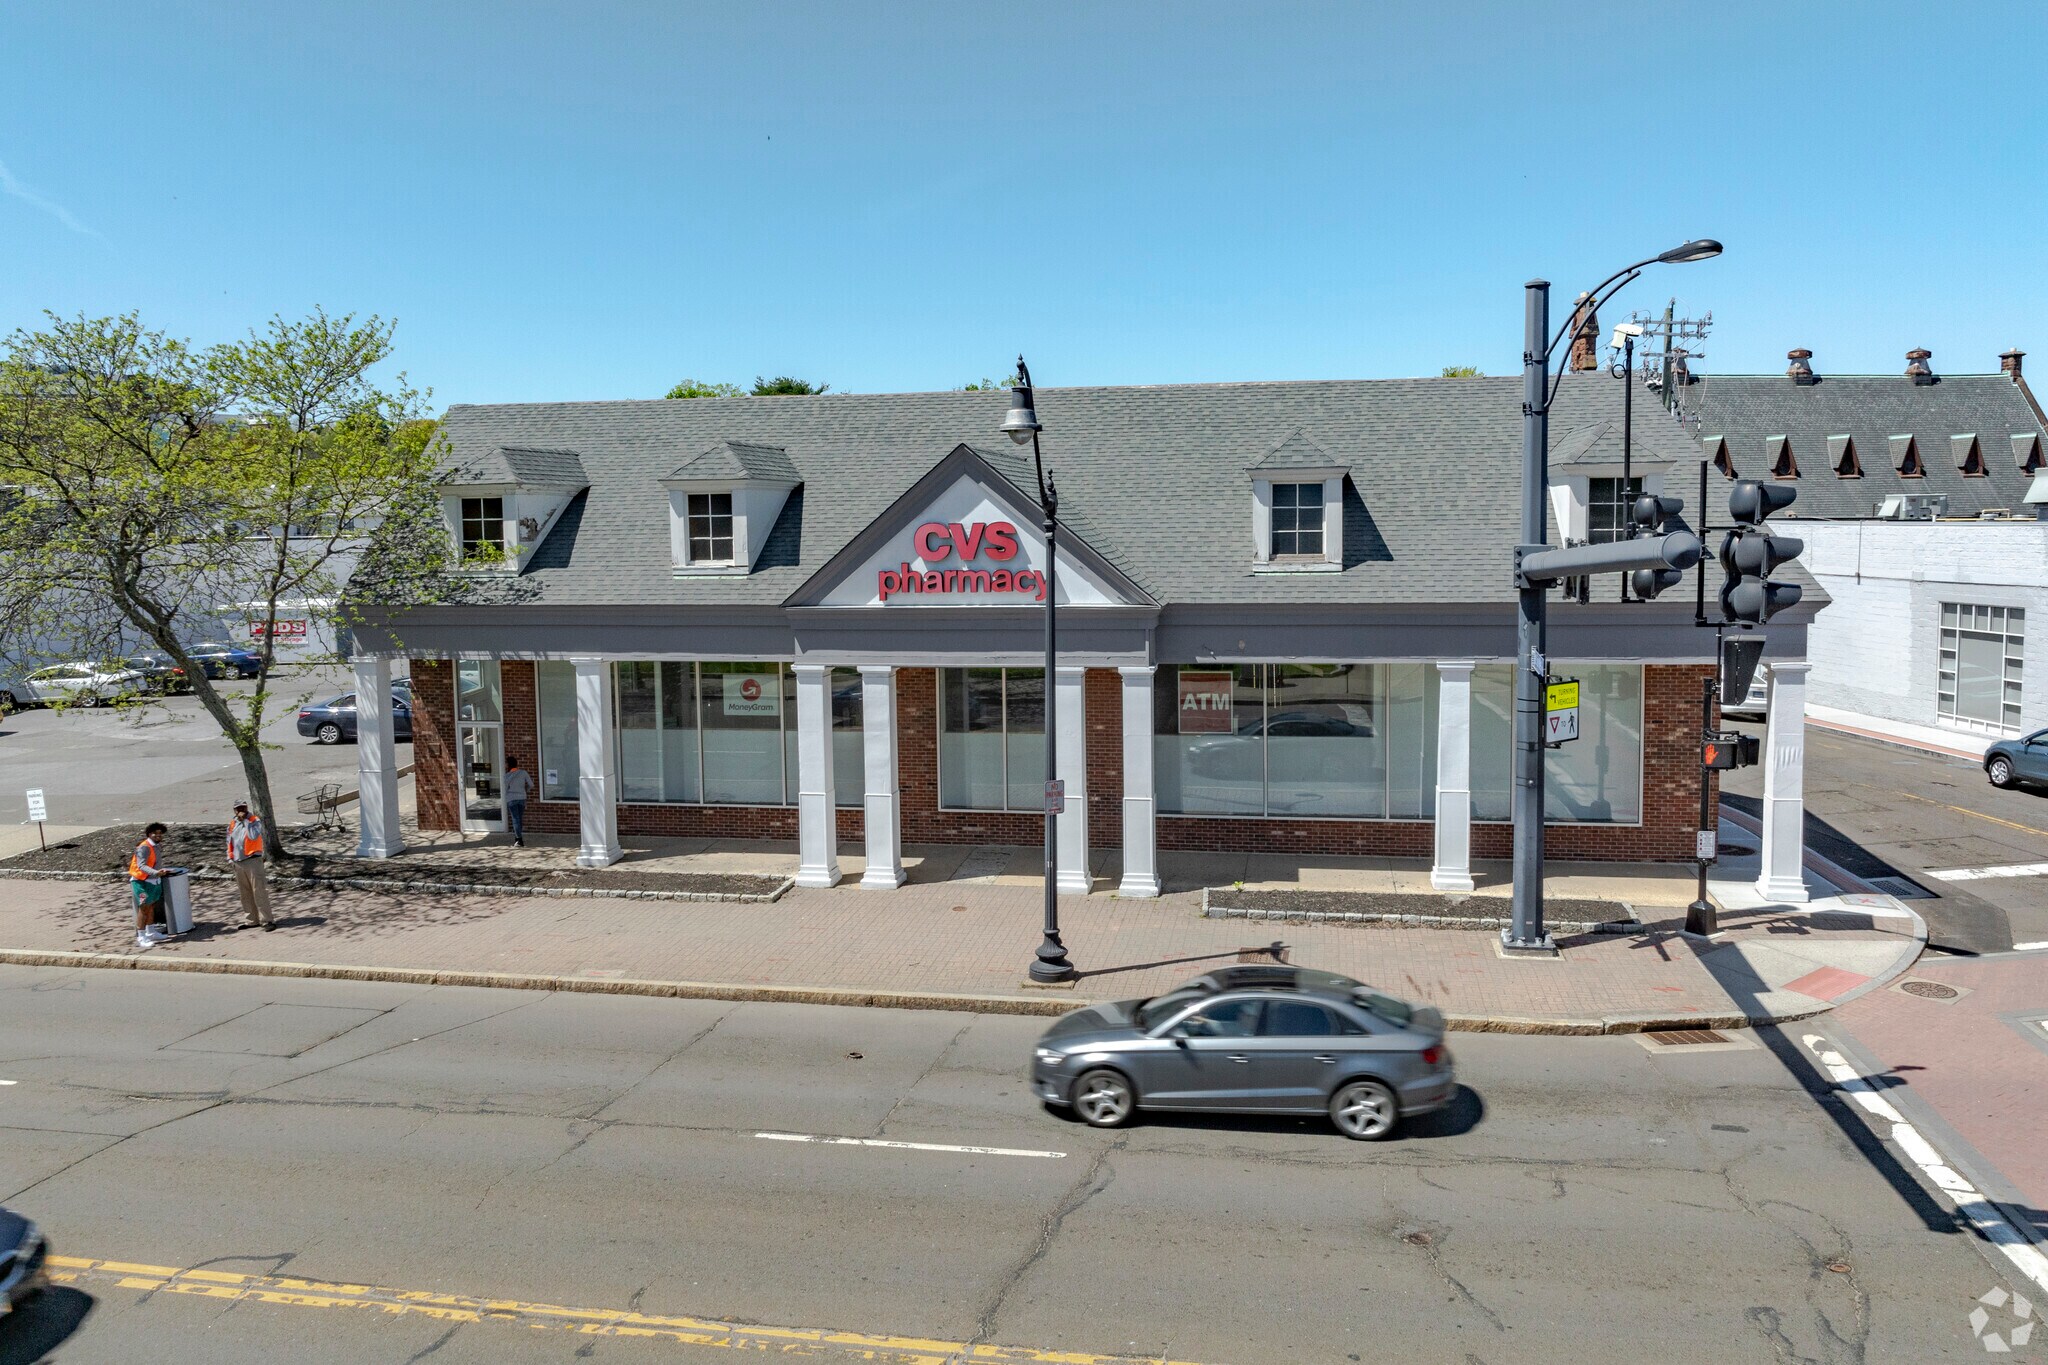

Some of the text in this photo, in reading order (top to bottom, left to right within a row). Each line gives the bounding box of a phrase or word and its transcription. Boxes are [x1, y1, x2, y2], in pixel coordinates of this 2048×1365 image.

[914, 521, 1019, 562] CVS
[878, 562, 1047, 601] pharmacy
[1558, 687, 1576, 696] TURNING
[728, 704, 774, 712] MoneyGram
[1182, 692, 1230, 711] ATM
[1557, 696, 1576, 706] VEHICLES
